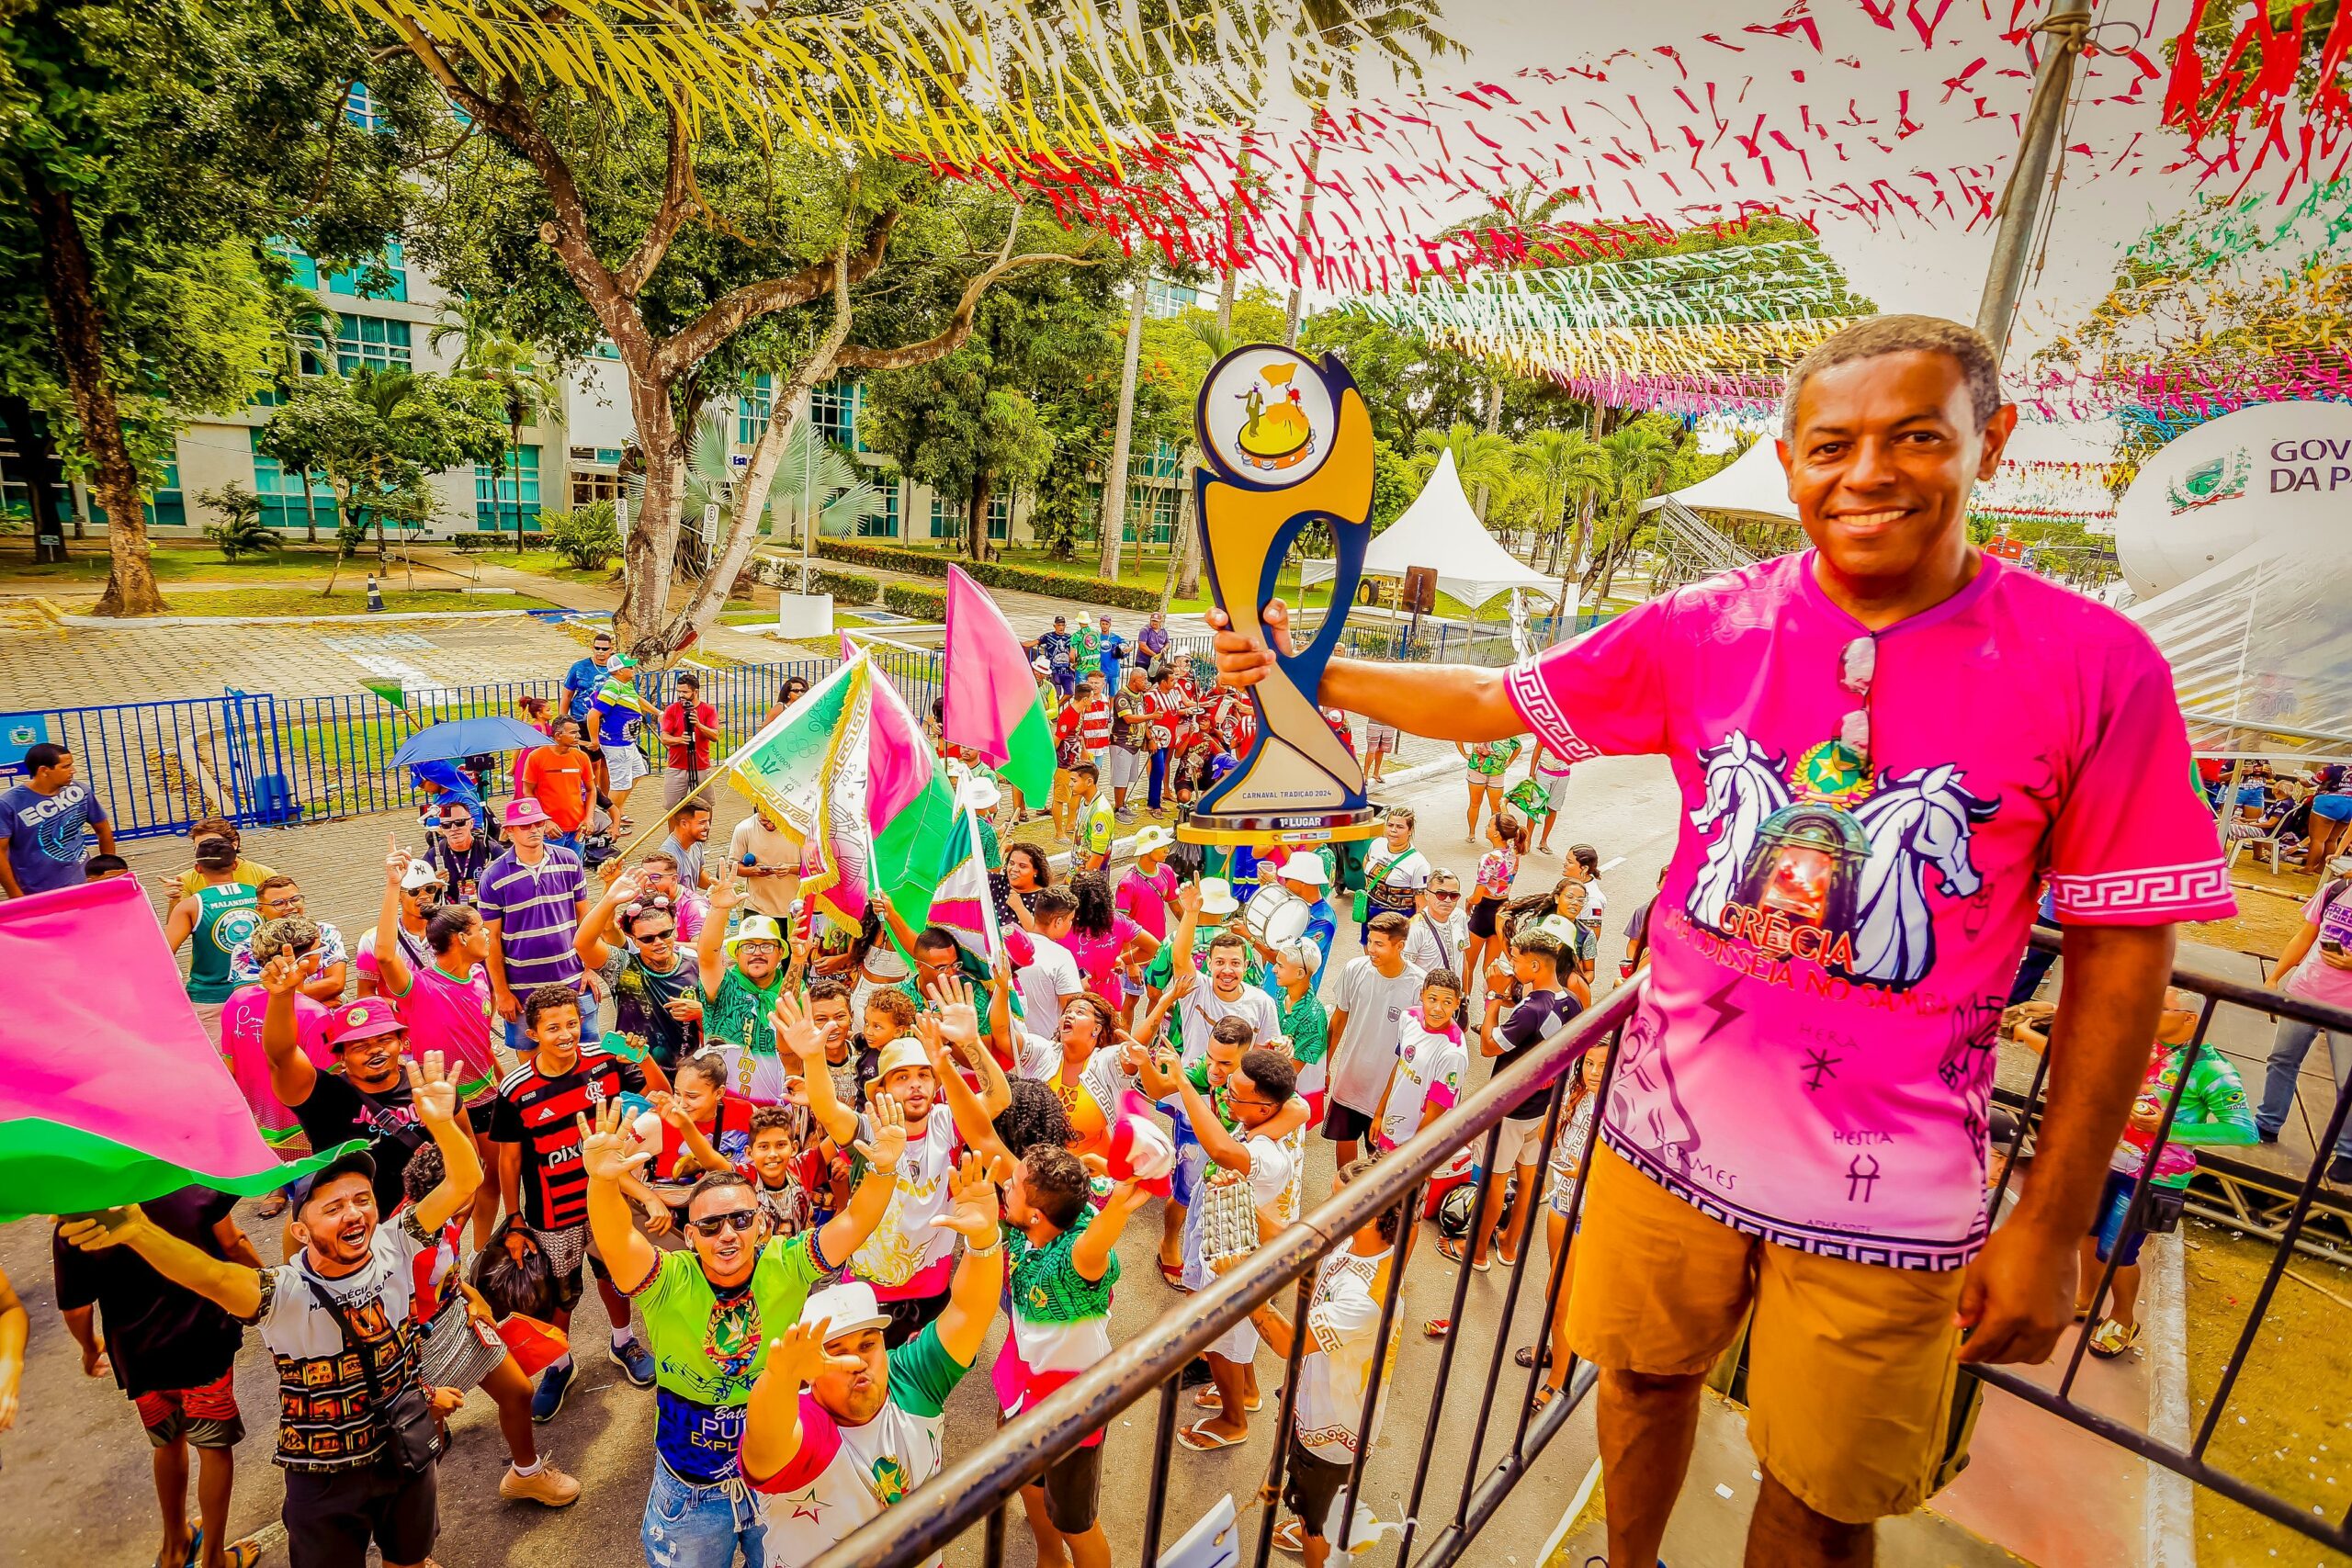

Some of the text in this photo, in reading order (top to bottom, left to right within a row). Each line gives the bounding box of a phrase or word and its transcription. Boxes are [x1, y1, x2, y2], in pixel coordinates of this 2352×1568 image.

[2270, 439, 2352, 462] GOV
[2270, 467, 2352, 493] DA P
[770, 743, 793, 771] POSEIDON
[17, 785, 85, 827] ECKO
[1242, 791, 1278, 799] CARNAVAL
[1289, 817, 1321, 827] LUGAR
[1718, 900, 1856, 976] GRÉCIA
[1804, 969, 1852, 1001] NO
[1862, 984, 1951, 1016] SAMBA
[1800, 1023, 1861, 1051] HERA
[1833, 1130, 1894, 1146] HESTIA
